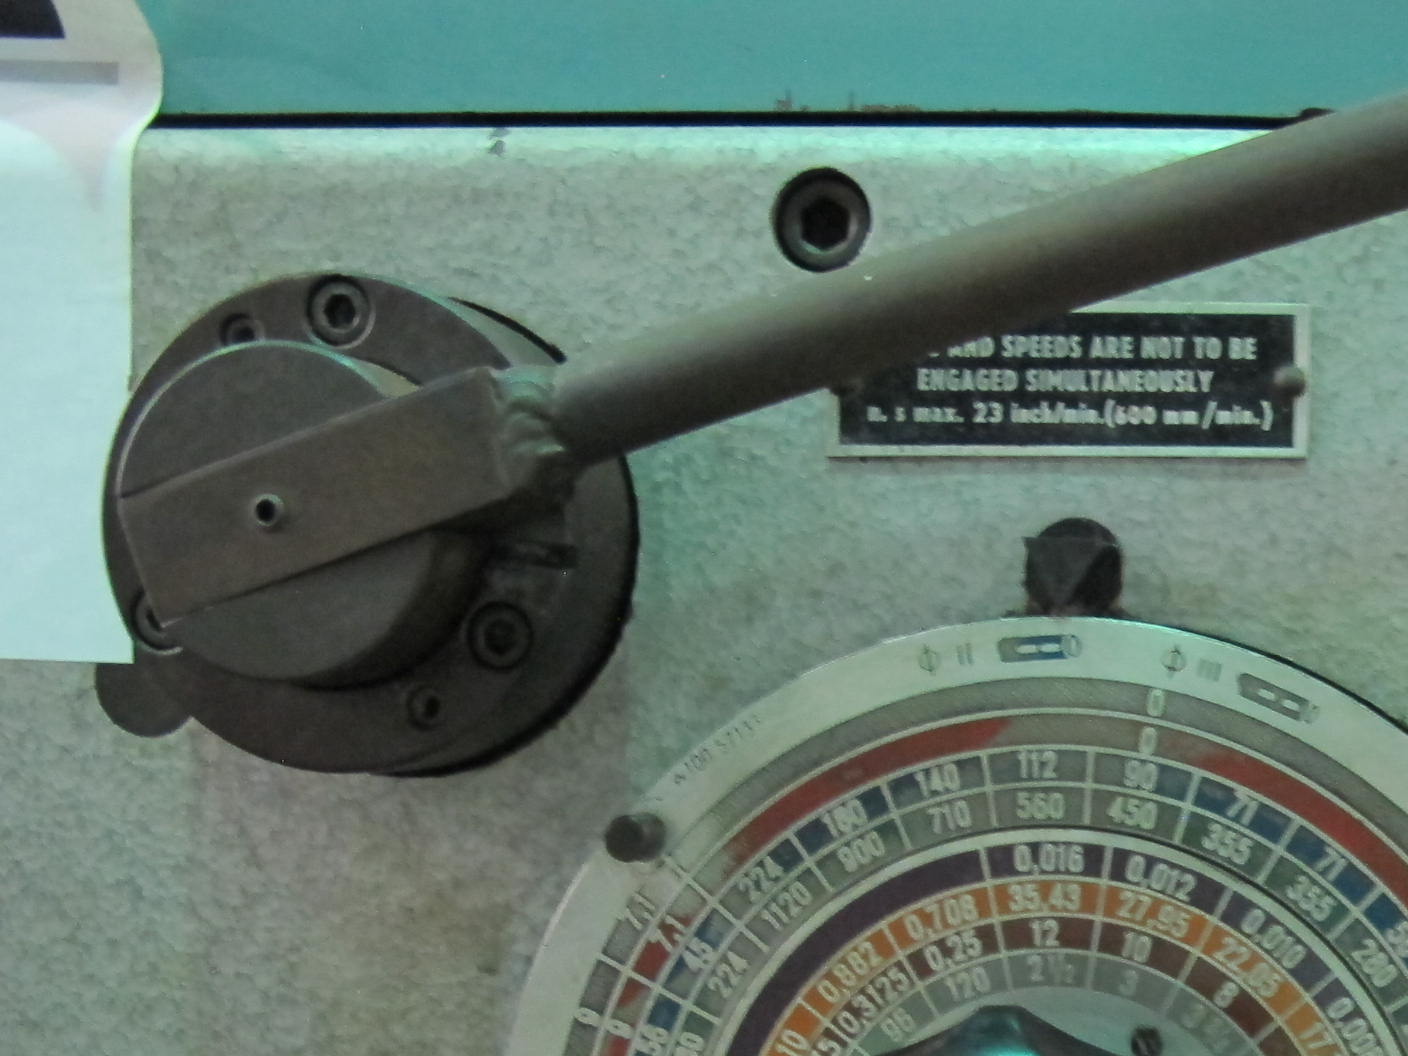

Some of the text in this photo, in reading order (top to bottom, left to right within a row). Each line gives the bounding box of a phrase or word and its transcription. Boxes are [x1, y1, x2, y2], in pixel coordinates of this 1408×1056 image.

[1000, 335, 1082, 359] SPEEDS
[1089, 336, 1133, 359] ARE
[1139, 337, 1186, 360] NOT
[1193, 338, 1222, 360] TO
[1227, 337, 1258, 360] BE
[915, 368, 1215, 393] ENGAGED SIMULTANEOUSLY
[911, 405, 964, 423] max.
[972, 401, 1005, 423] 23
[1145, 687, 1167, 718] 0
[1138, 725, 1158, 755] 0
[680, 937, 714, 972] 45
[739, 856, 784, 901] 224
[915, 762, 961, 799] 140
[1016, 748, 1058, 780] 112
[1225, 790, 1259, 825] 71
[1314, 848, 1346, 879] 71
[708, 951, 749, 997] 224
[763, 881, 812, 930] 1120
[837, 831, 885, 872] 900
[927, 799, 972, 835] 710
[1013, 789, 1065, 821] 560
[1105, 795, 1159, 829] 450
[1201, 822, 1255, 864] 355
[1288, 874, 1336, 920] 355
[1012, 841, 1085, 876] 0,016
[1124, 854, 1197, 900] 0,012
[1239, 907, 1306, 969] 0,010
[817, 939, 882, 1005] 0,882
[904, 890, 978, 946] 0,708
[1006, 880, 1081, 915] 35,43
[837, 963, 908, 1035] 0,3125
[923, 927, 984, 975] 0,25
[1030, 919, 1059, 947] 12
[1120, 931, 1153, 963] 10
[1213, 980, 1239, 1008] 8
[944, 960, 989, 999] 120
